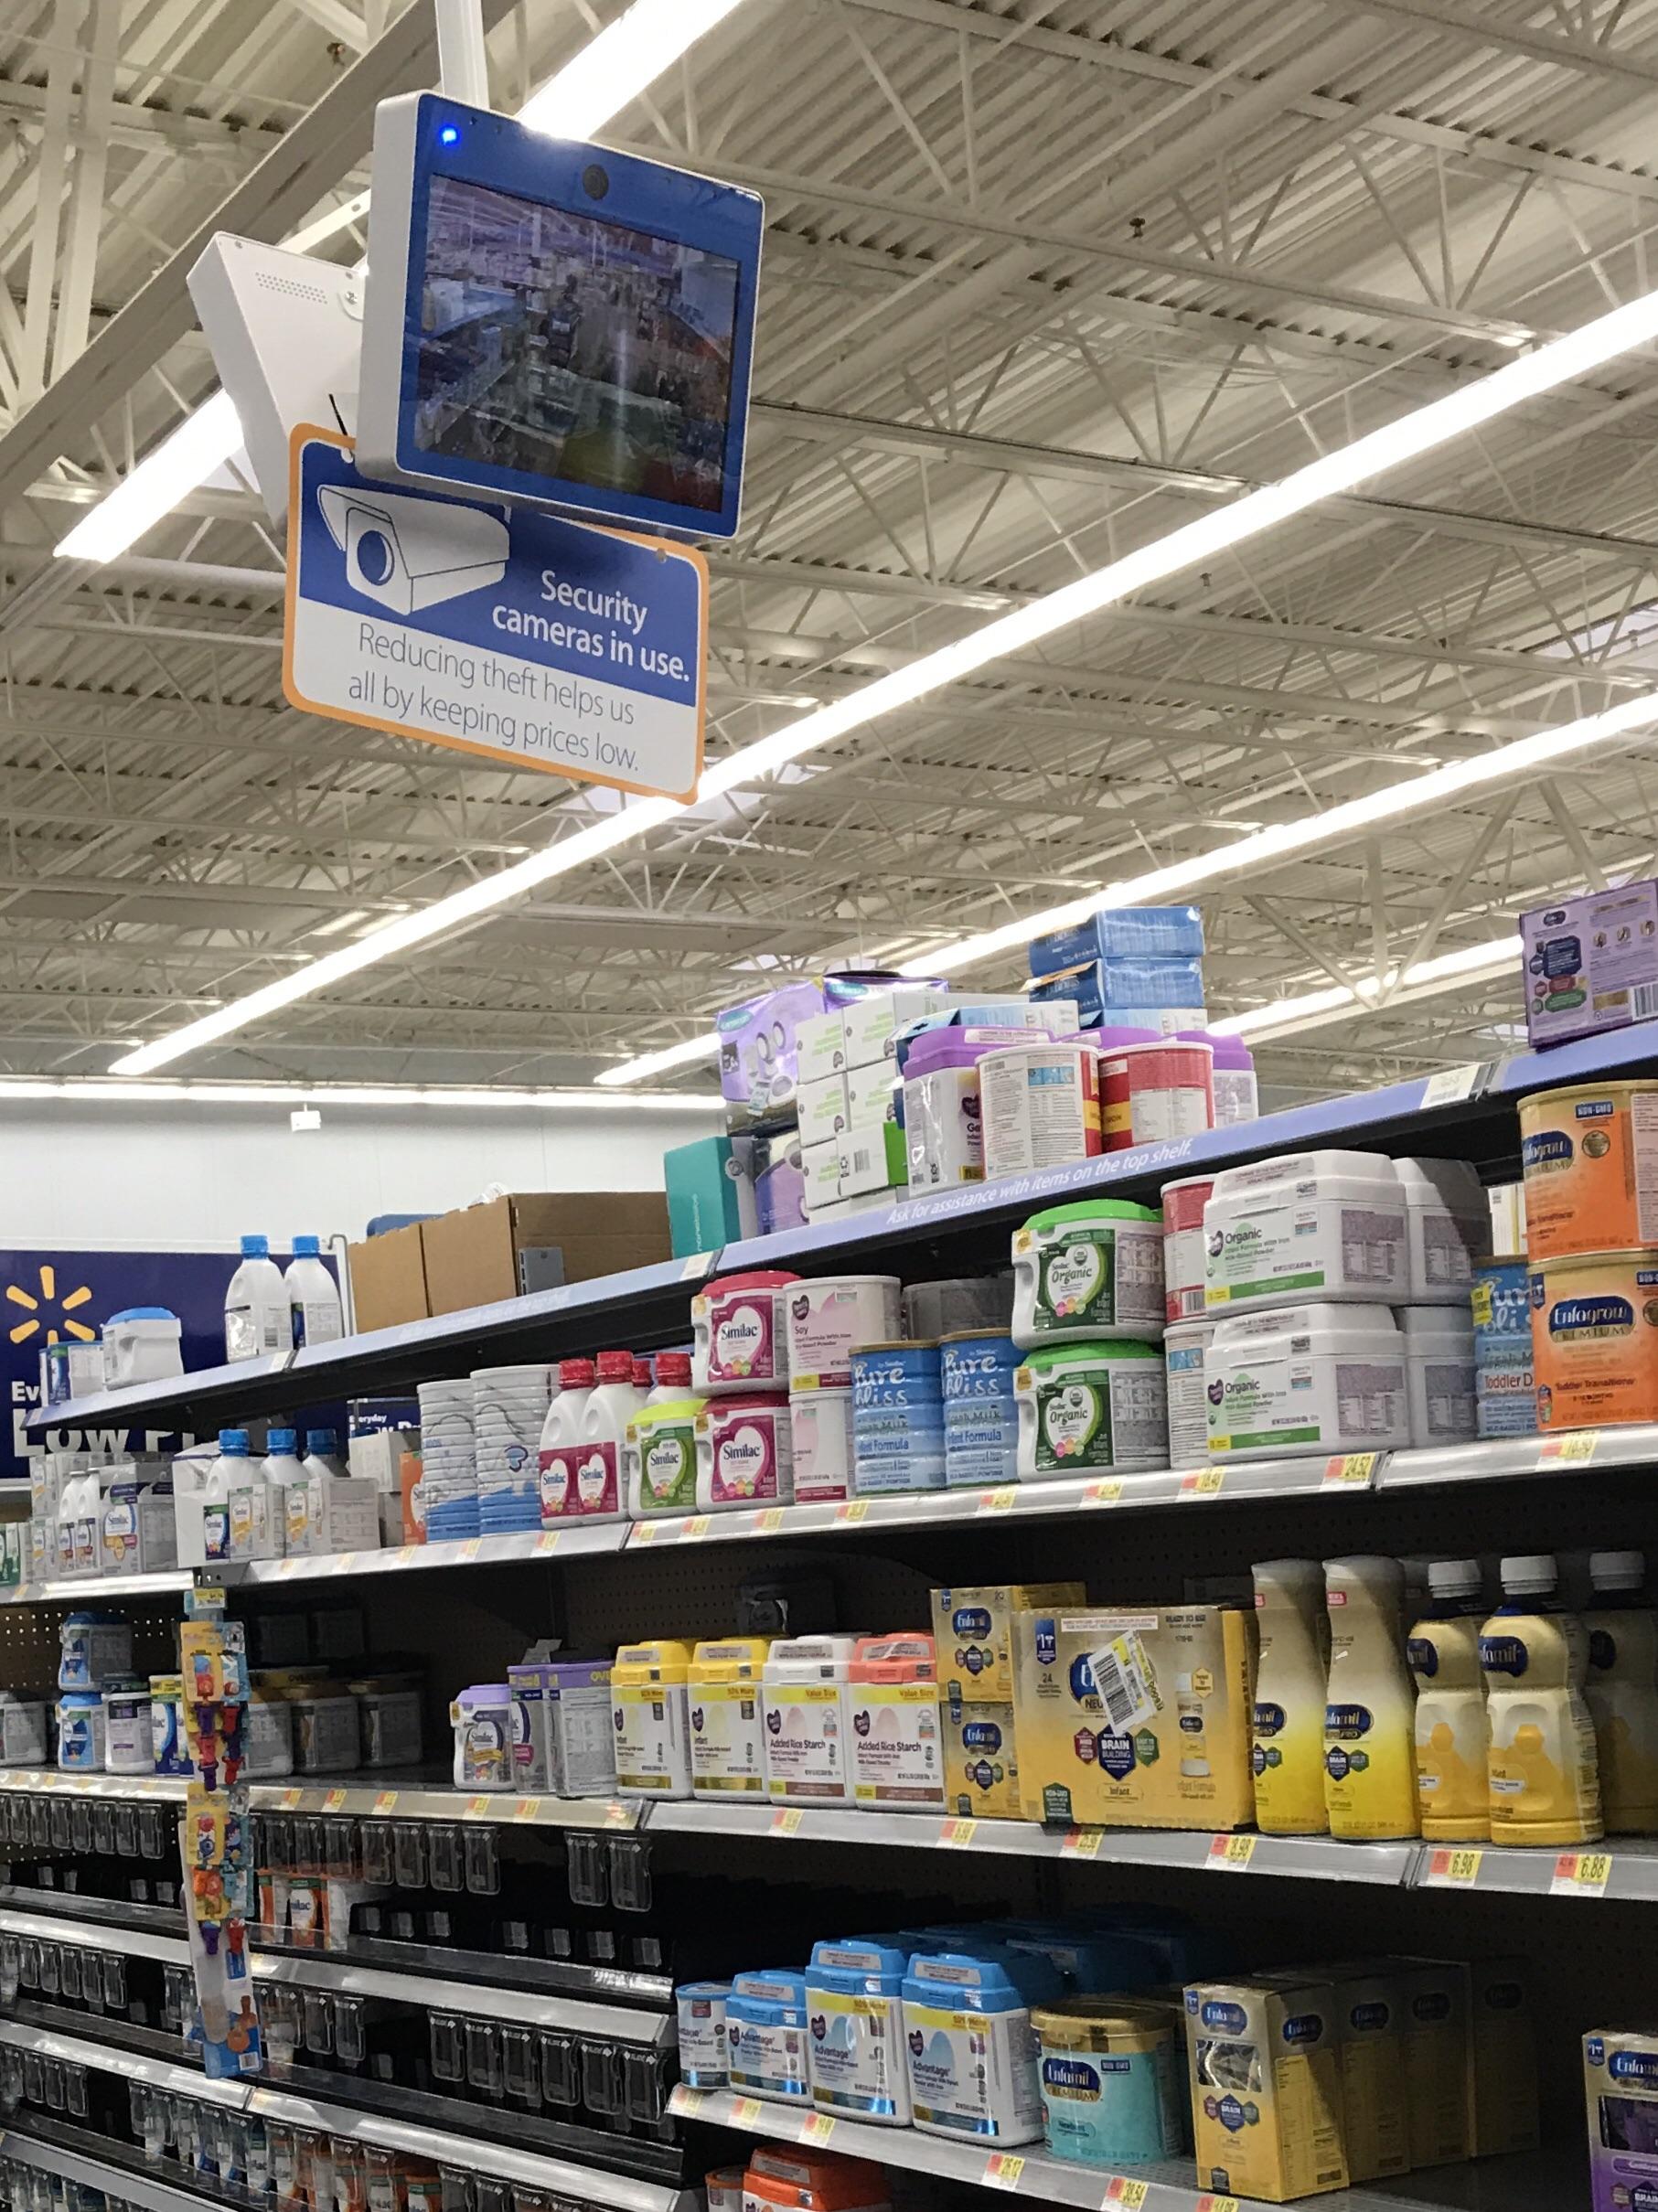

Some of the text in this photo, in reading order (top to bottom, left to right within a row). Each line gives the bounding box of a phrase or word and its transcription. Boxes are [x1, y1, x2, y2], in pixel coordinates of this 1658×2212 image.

[540, 568, 647, 634] Security
[492, 603, 690, 682] cameras in use.
[358, 622, 635, 725] Reducing theft helps us
[348, 669, 639, 772] all by keeping prices low.
[885, 1138, 1193, 1225] Ask for assistance with items on the top shelf.
[1225, 1228, 1262, 1245] Organic
[1052, 1267, 1093, 1285] Organic
[1554, 1307, 1628, 1326] Enfagrow
[721, 1322, 758, 1341] Similac
[794, 1325, 808, 1336] Soy
[1225, 1379, 1260, 1395] Organic
[1484, 1374, 1521, 1389] Toddler
[349, 1414, 387, 1425] Eeryday
[1050, 1409, 1088, 1425] Organic
[965, 1428, 1002, 1442] Formula
[723, 1444, 761, 1460] Similac
[873, 1438, 909, 1451] Formula
[650, 1451, 679, 1466] Similac
[957, 1614, 985, 1628] Enfa
[967, 1728, 996, 1742] Enfa
[804, 1739, 826, 1749] Starch
[857, 1741, 922, 1753] Added Rice Starch
[1101, 1739, 1130, 1750] BRAIN
[1451, 1853, 1475, 1875] 6.98
[1579, 1854, 1606, 1878] 6.88
[1047, 2064, 1090, 2086] Enfamil
